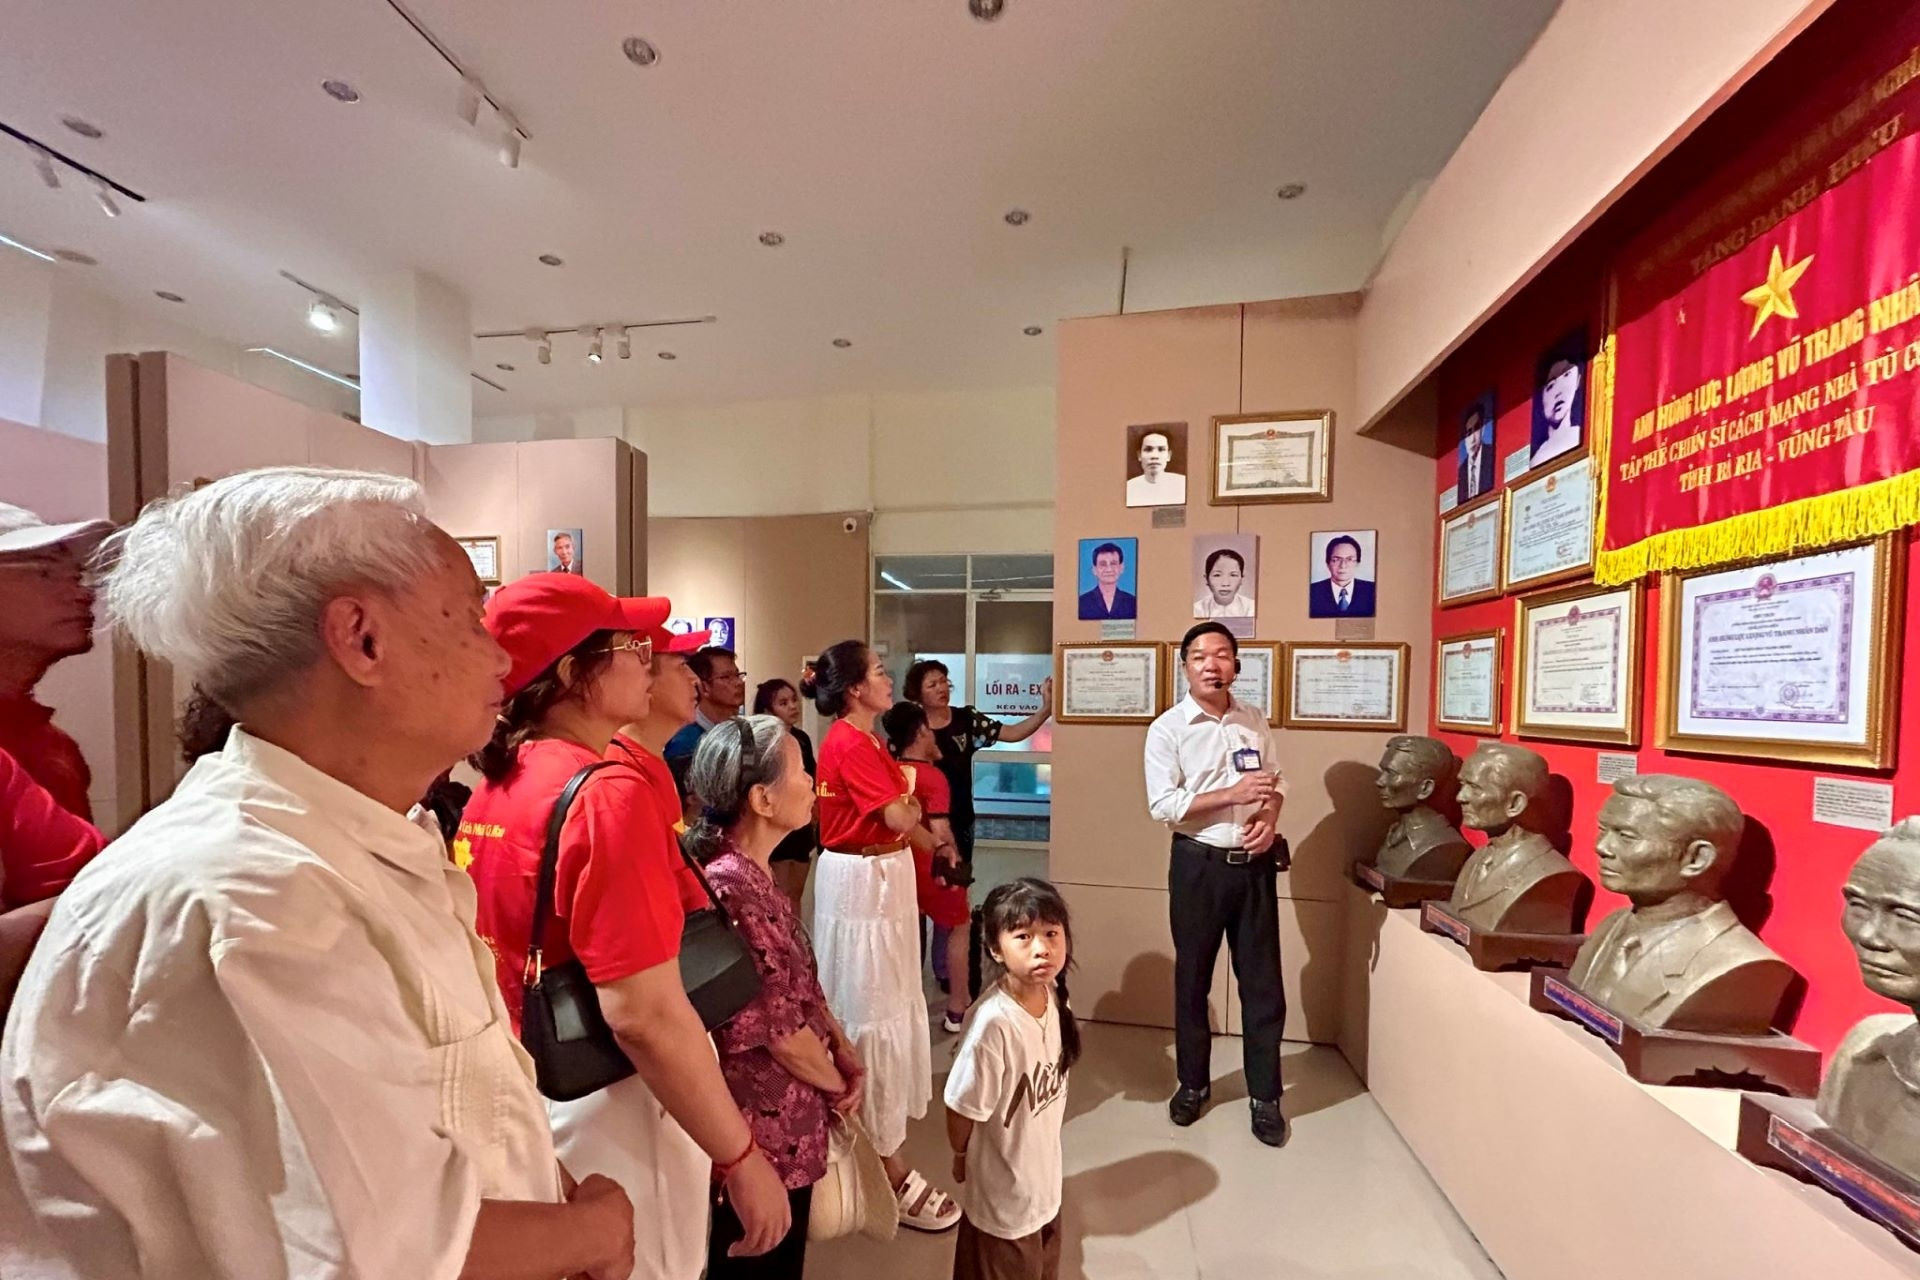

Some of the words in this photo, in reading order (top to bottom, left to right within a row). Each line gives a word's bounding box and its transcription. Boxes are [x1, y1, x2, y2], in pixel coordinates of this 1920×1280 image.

[1725, 355, 1774, 404] LƯỢNG
[1776, 334, 1801, 380] VŨ
[1803, 307, 1864, 366] TRANG
[1620, 455, 1643, 484] TẬP
[1708, 419, 1728, 449] SĨ
[1728, 410, 1764, 443] CÁCH
[1768, 385, 1820, 427] MẠNG
[1823, 361, 1858, 406] NHÀ
[1734, 448, 1762, 481] RỊA
[1777, 422, 1831, 462] VŨNG
[1833, 406, 1876, 443] TÀU
[985, 680, 1002, 695] LỐI
[1006, 683, 1019, 695] RA
